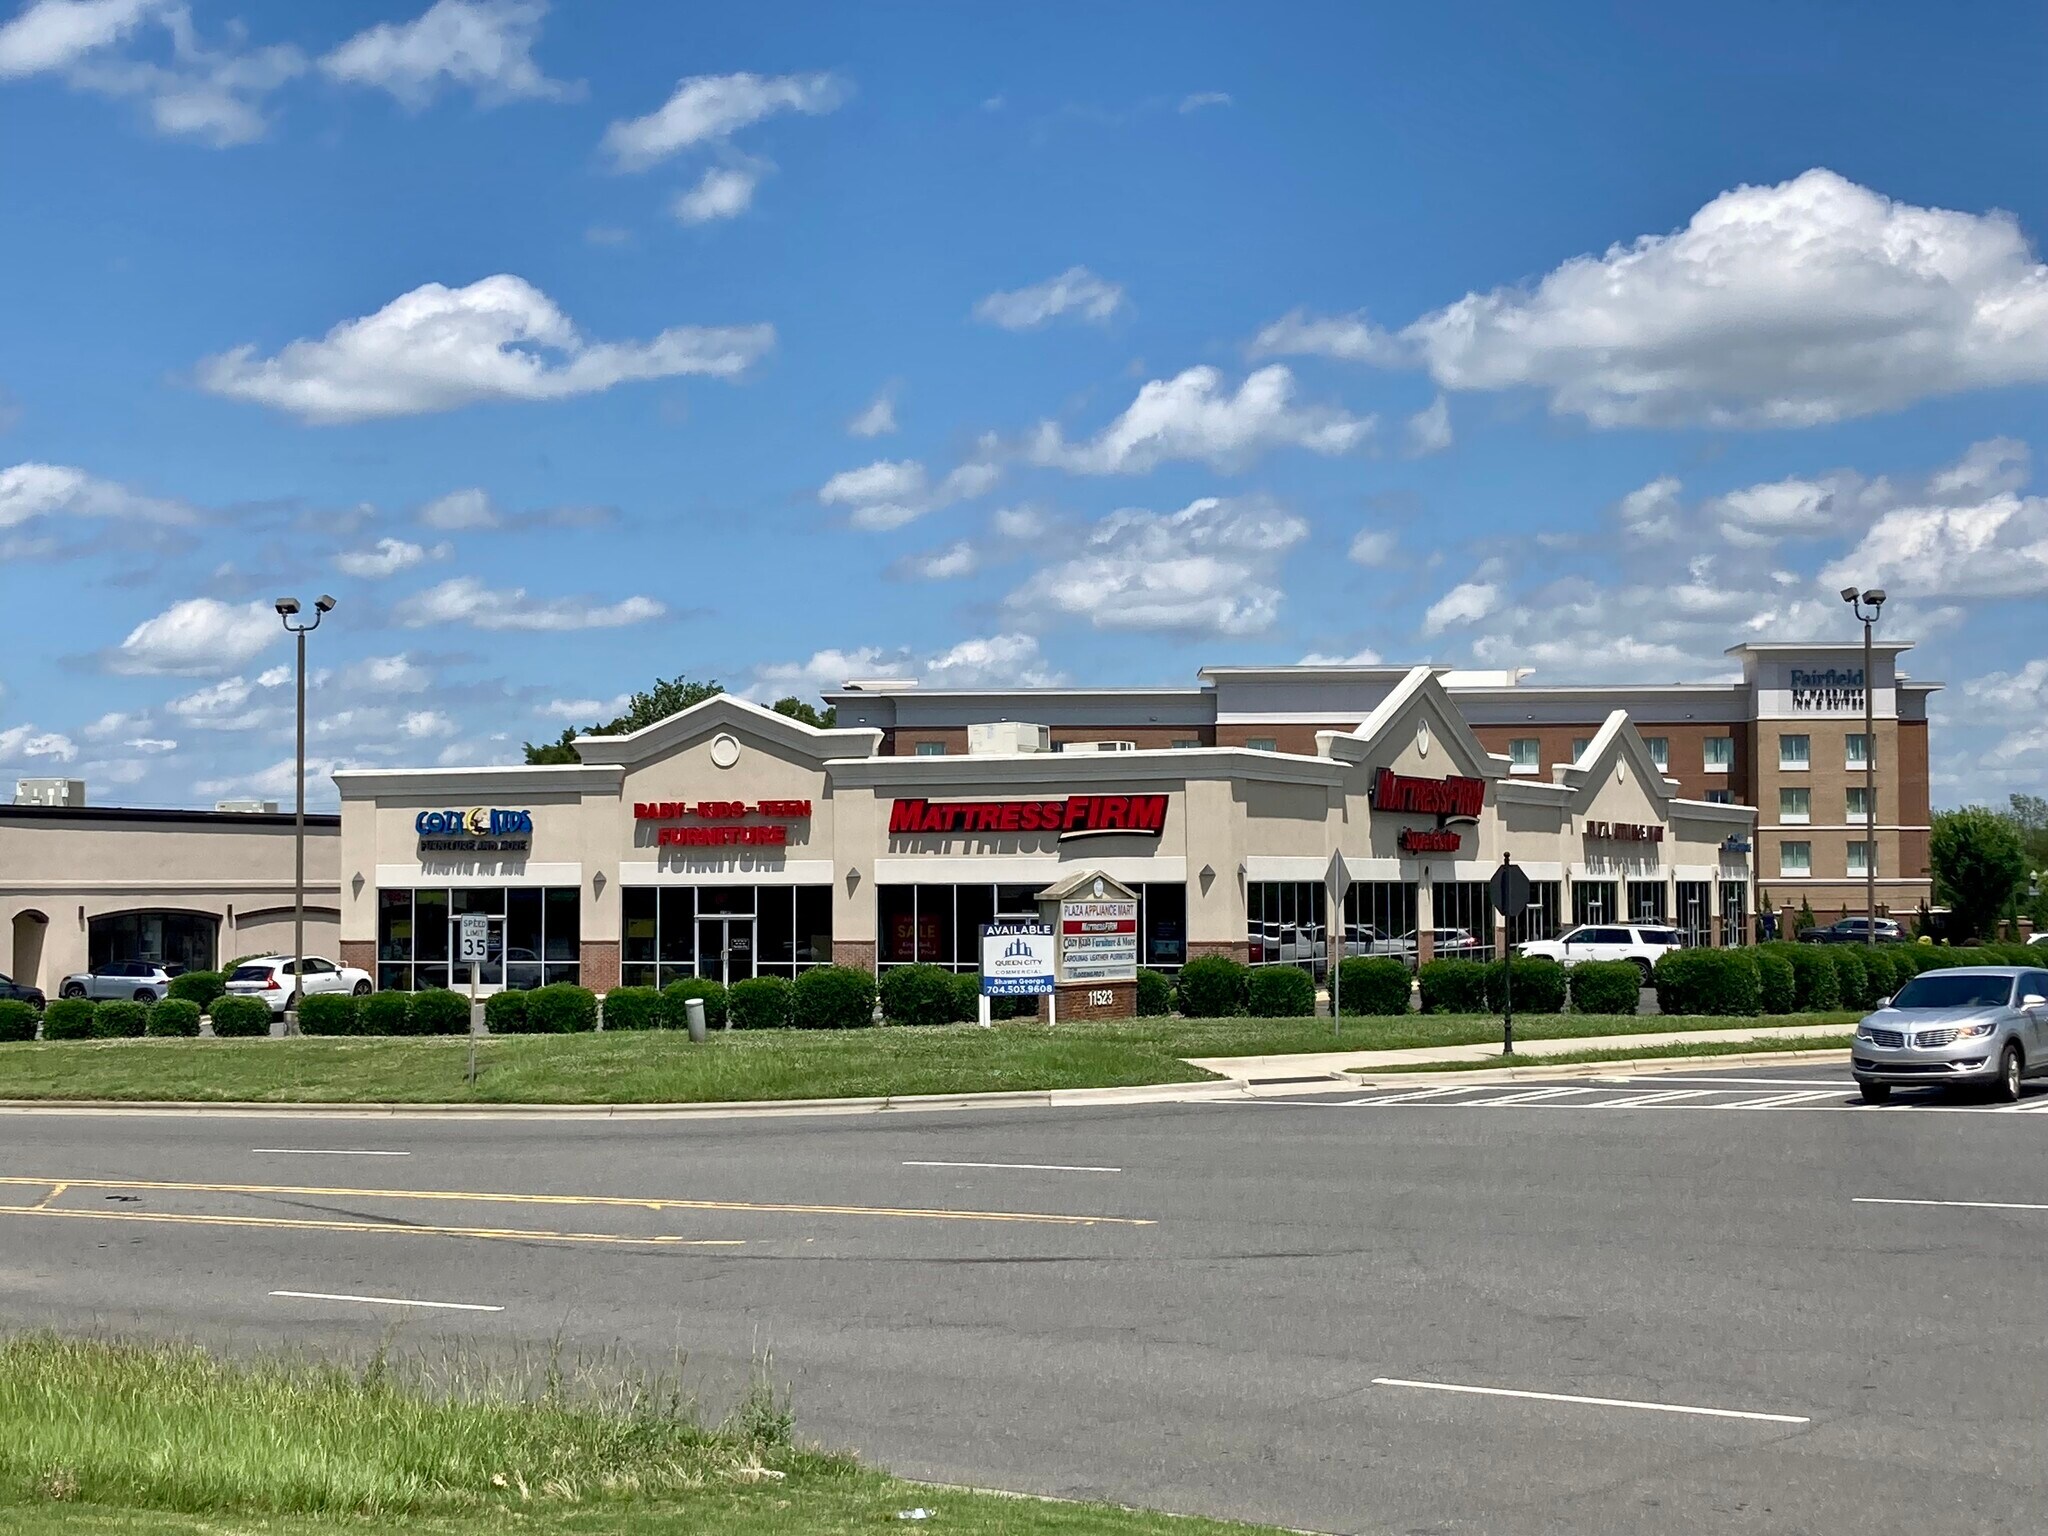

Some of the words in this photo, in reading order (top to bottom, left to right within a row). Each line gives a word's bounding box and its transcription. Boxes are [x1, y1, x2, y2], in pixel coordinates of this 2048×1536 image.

[1790, 669, 1864, 687] Fairfield
[415, 811, 466, 835] COZY
[490, 808, 533, 836] KIDS
[658, 826, 787, 846] FURNITURE
[1064, 904, 1084, 917] PLAZA
[1084, 904, 1117, 916] APPLIANCE
[1117, 904, 1134, 916] MART
[463, 919, 486, 928] SPEED
[986, 925, 1051, 935] AVAILABLE
[466, 929, 484, 937] LIMIT
[463, 939, 486, 956] 35
[986, 984, 1053, 994] 704.503.9608
[1088, 989, 1113, 1006] 11523
